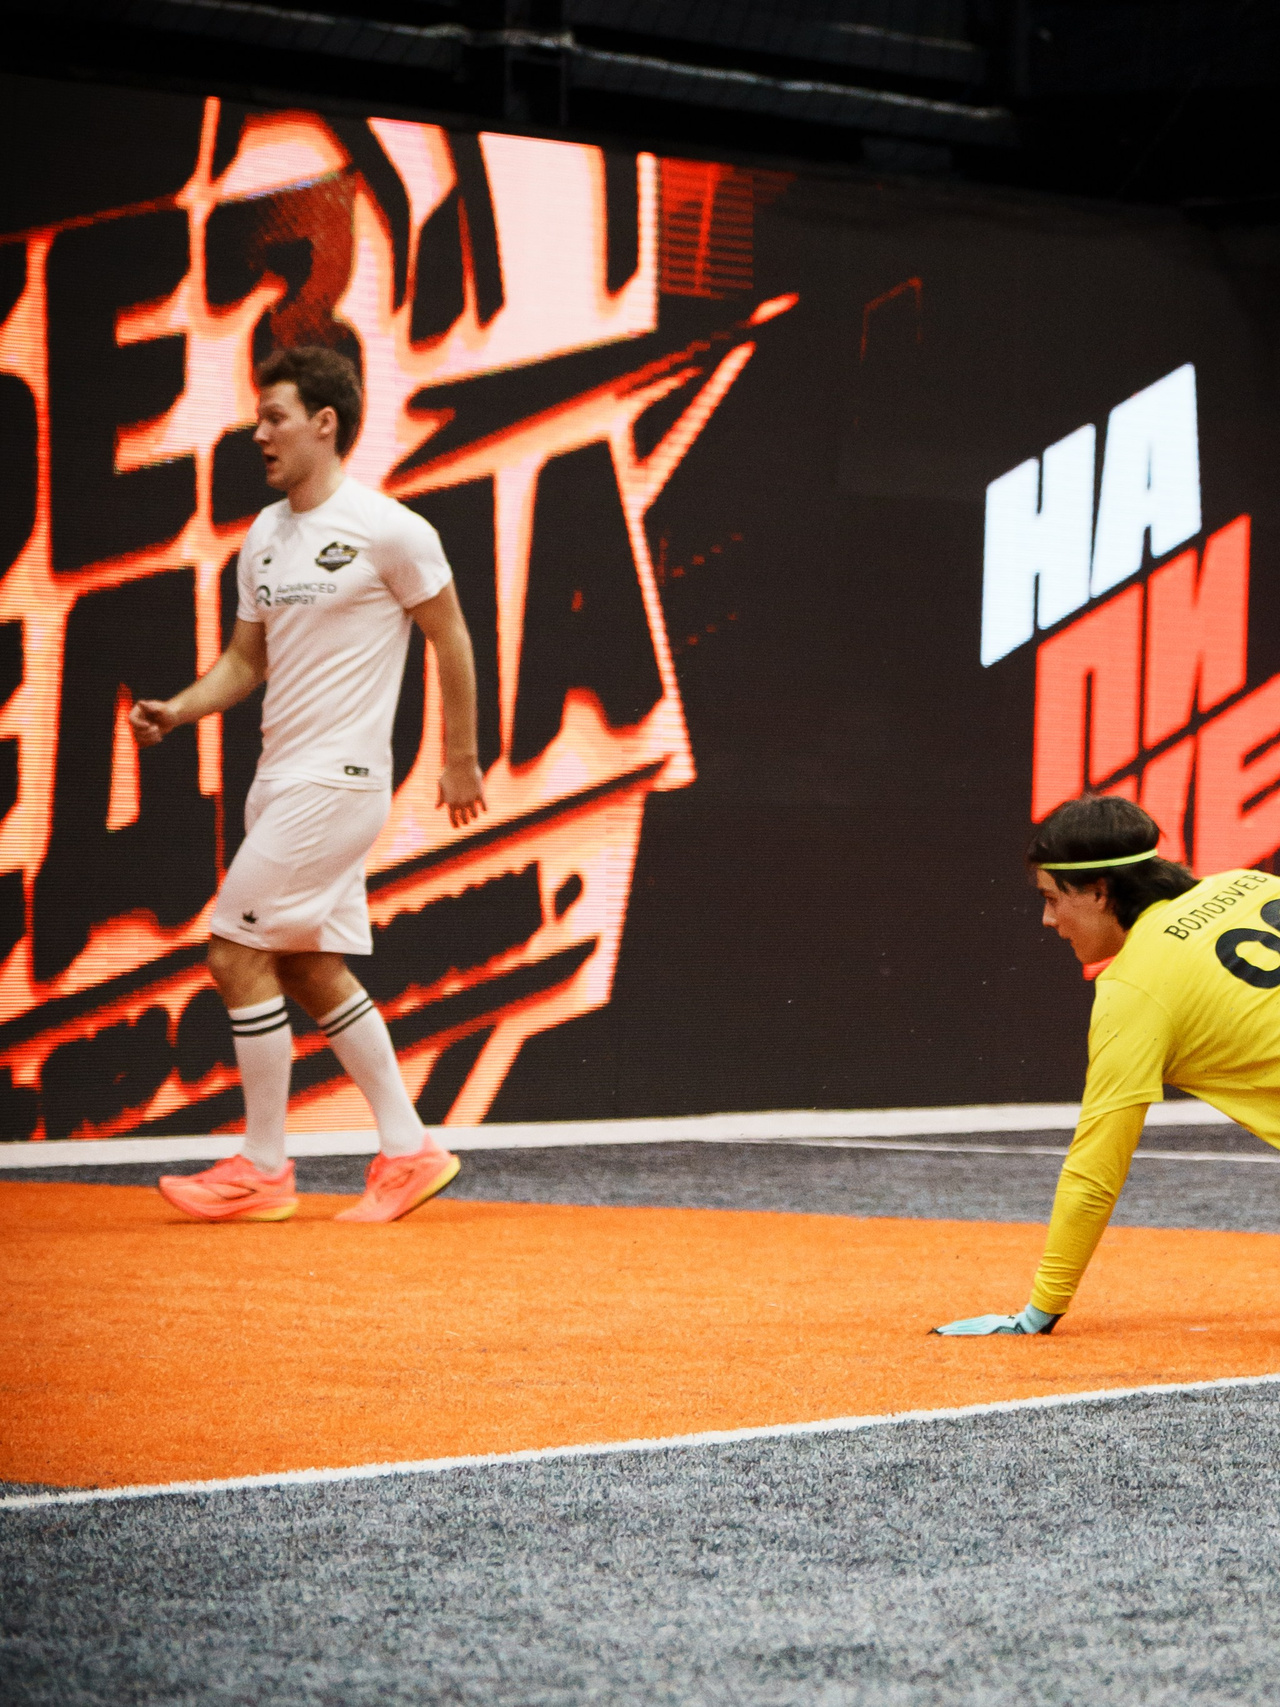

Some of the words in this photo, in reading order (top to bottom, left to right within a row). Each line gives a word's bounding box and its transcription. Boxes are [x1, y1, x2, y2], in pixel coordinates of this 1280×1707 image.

[980, 361, 1202, 668] НА
[274, 594, 317, 606] ENERGY
[1163, 874, 1269, 941] ВОЛОБУЕВ
